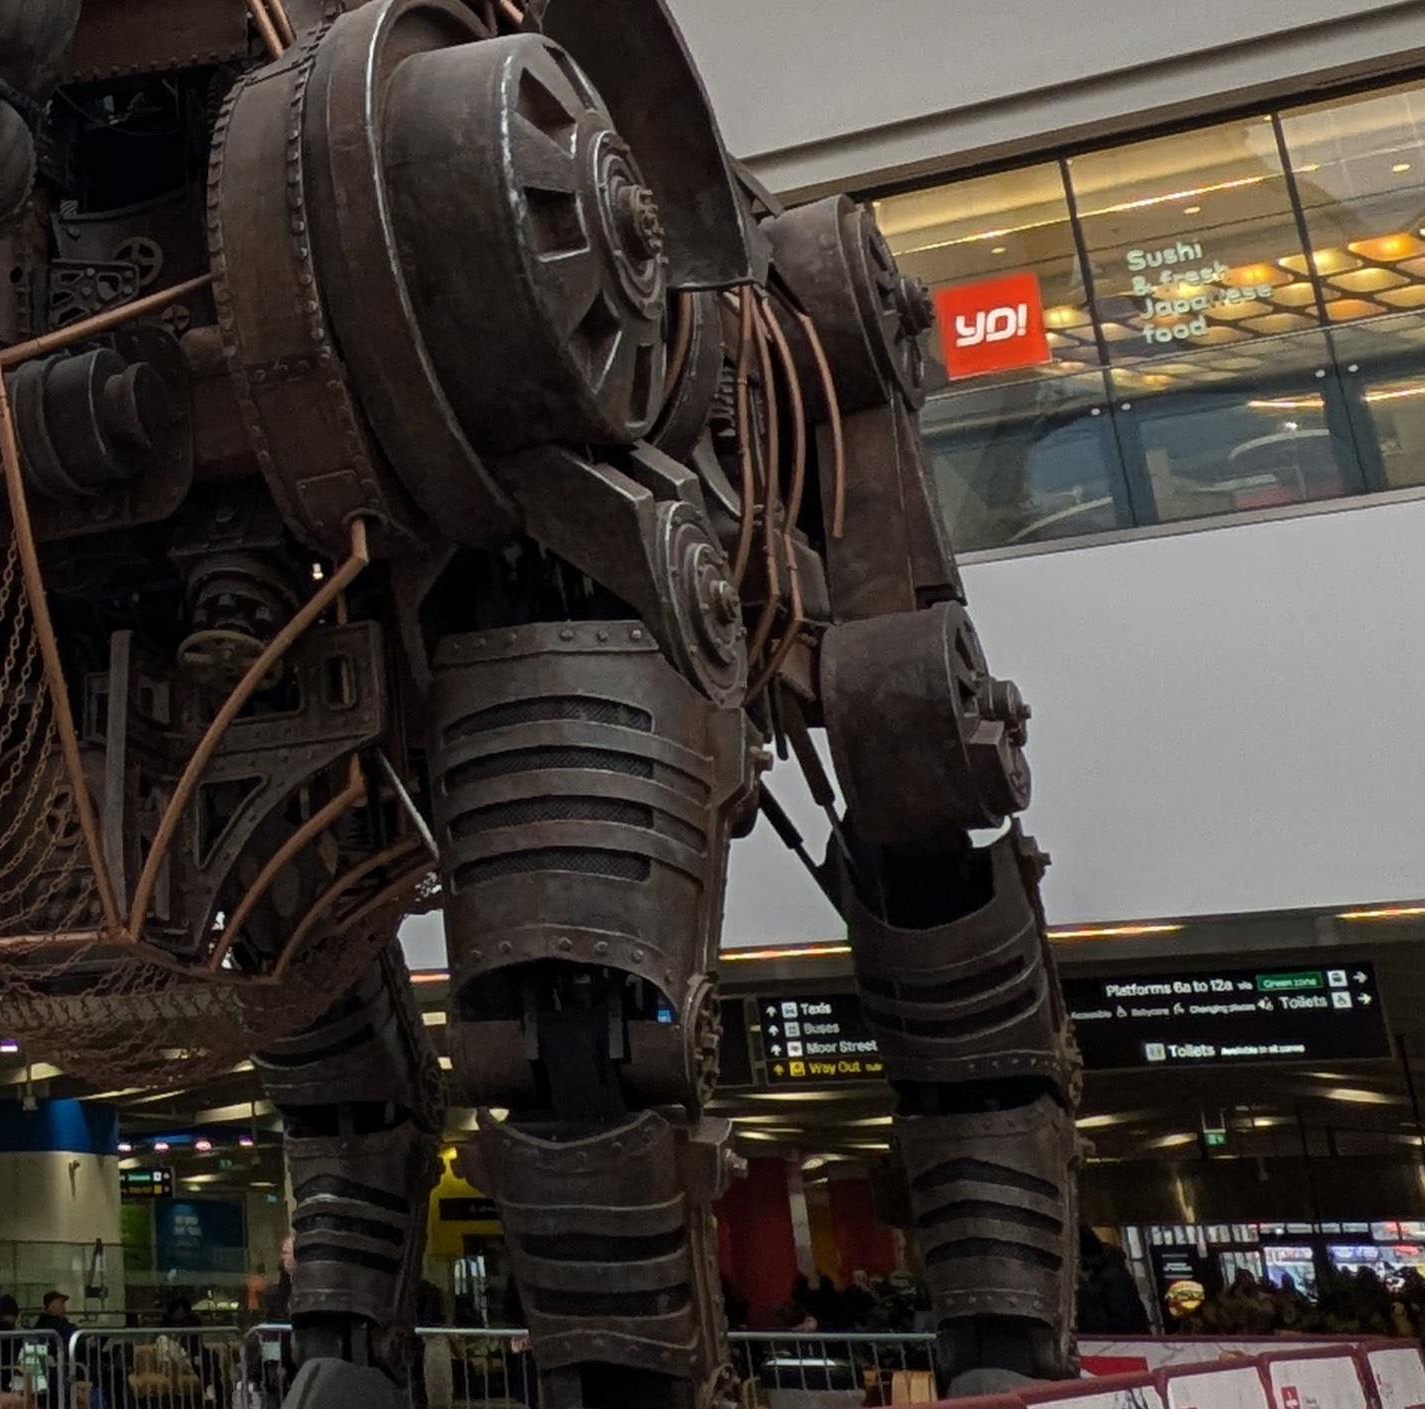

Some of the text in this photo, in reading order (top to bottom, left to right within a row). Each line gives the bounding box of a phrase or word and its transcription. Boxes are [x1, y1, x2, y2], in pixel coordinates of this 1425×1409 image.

[1126, 239, 1204, 272] Sushi
[1132, 260, 1230, 297] & fresh
[1139, 284, 1273, 321] Japanese
[955, 303, 1028, 348] YO!
[1141, 314, 1209, 344] food
[1105, 982, 1172, 997] Platforms
[1173, 981, 1191, 993] 6a
[1192, 980, 1208, 992] to
[1210, 978, 1233, 992] 12a
[800, 1002, 832, 1016] Taxis
[1278, 995, 1328, 1010] Toilets
[803, 1022, 841, 1035] Buses
[806, 1039, 878, 1055] Moor Street
[1167, 1043, 1216, 1058] Toilets
[808, 1063, 836, 1075] Way
[837, 1061, 861, 1073] Out
